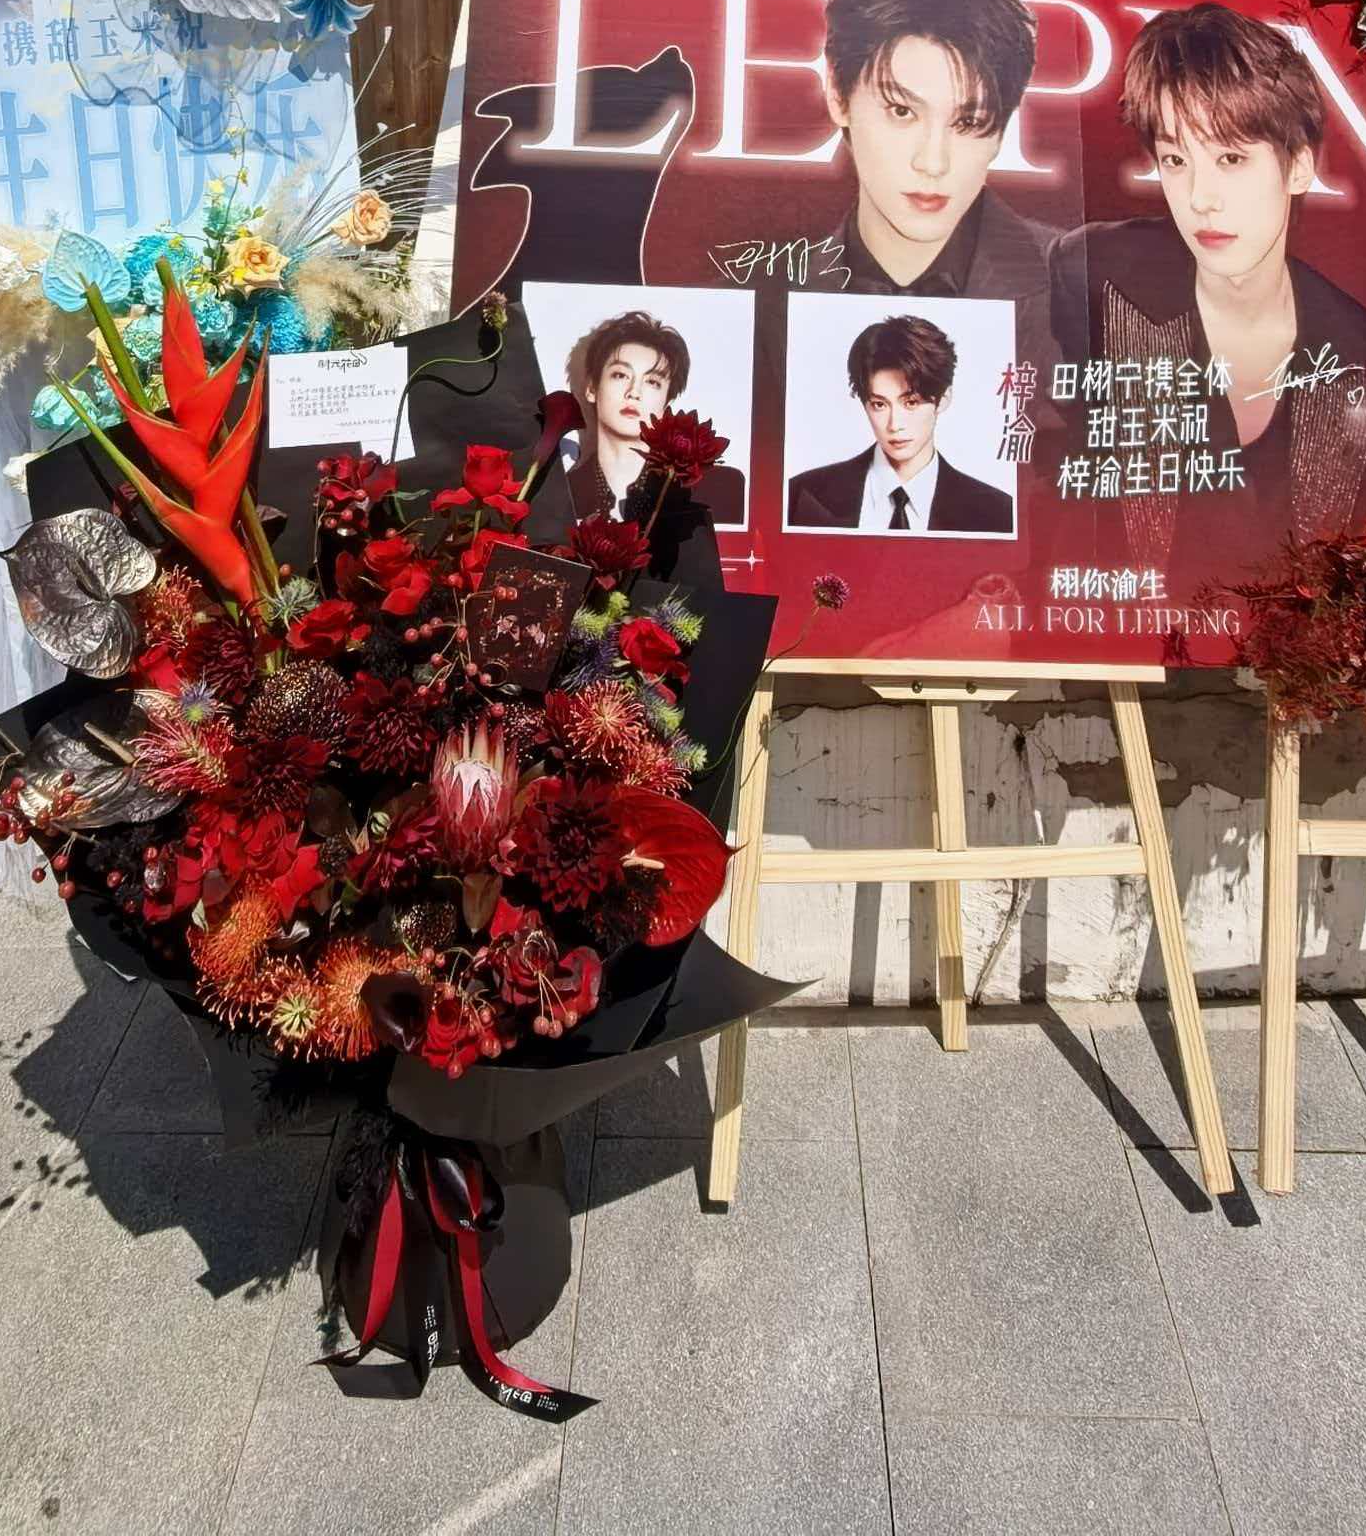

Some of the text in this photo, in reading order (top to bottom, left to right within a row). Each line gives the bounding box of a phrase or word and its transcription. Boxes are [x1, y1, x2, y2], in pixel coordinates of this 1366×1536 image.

[1051, 355, 1233, 402] 田栩宁携全体
[1087, 404, 1210, 448] 甜玉米祝
[1057, 448, 1246, 500] 梓渝生日快乐
[1050, 567, 1169, 602] 栩你渝生
[973, 604, 1241, 636] ALL FOR LEIPENG
